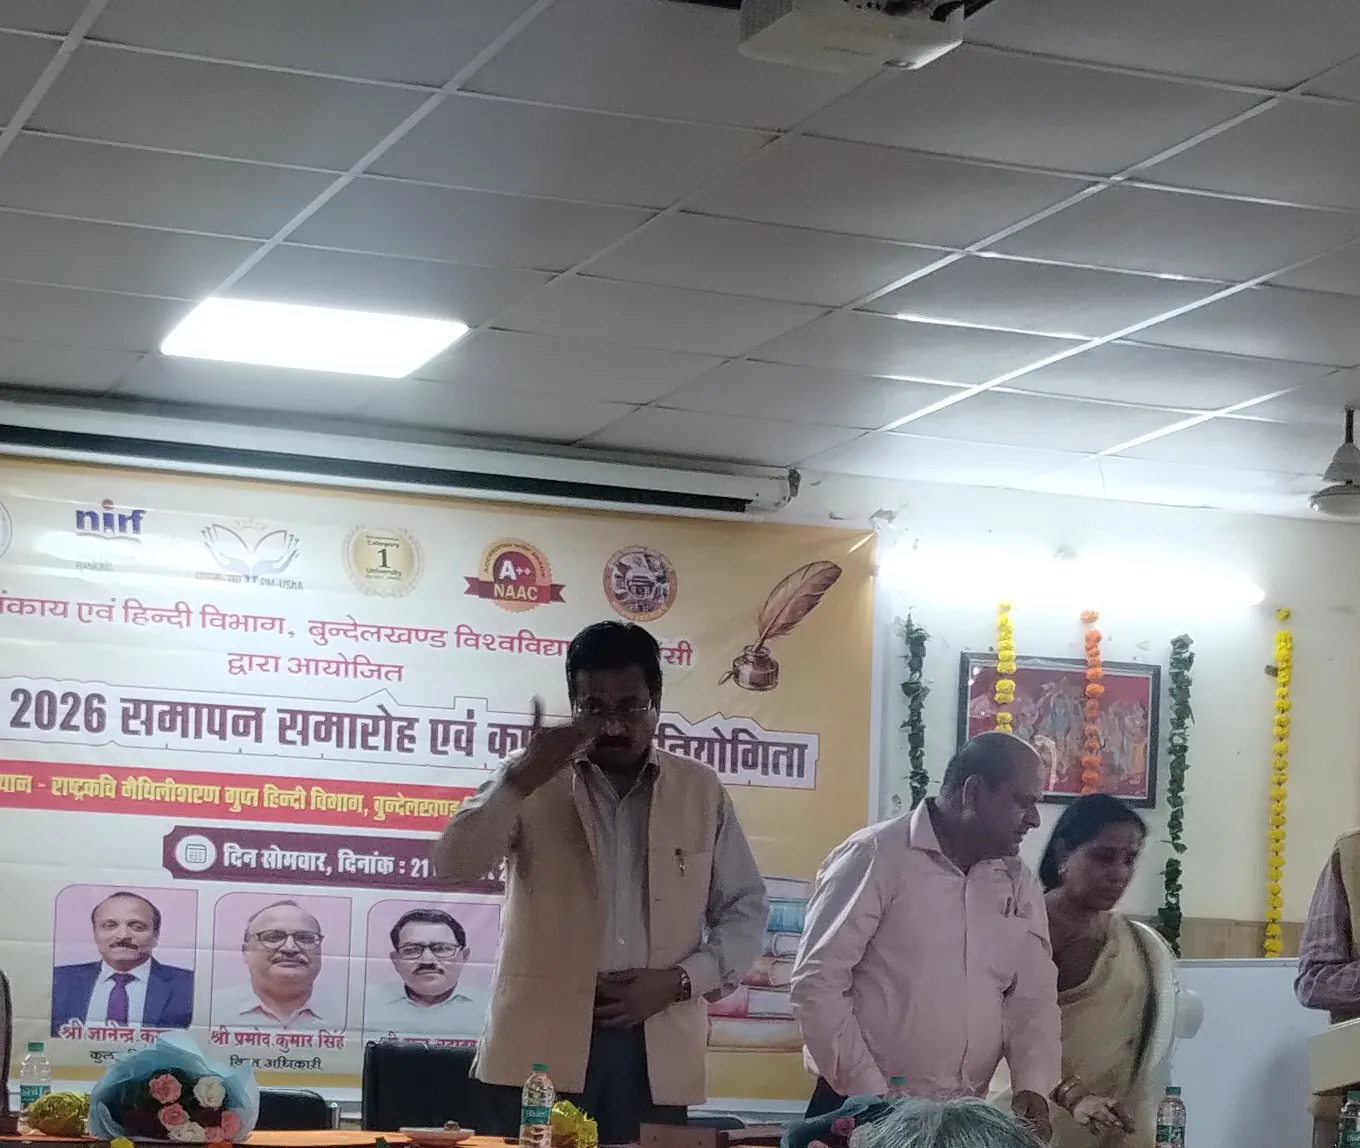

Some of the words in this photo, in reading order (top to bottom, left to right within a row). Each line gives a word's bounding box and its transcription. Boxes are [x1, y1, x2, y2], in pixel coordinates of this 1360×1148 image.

[75, 498, 147, 535] nirf
[377, 549, 391, 568] 1
[499, 560, 532, 580] A++
[493, 583, 538, 601] NAAC
[77, 597, 116, 624] एवं
[122, 598, 193, 629] हिन्दी
[199, 604, 295, 638] विभाग,
[308, 615, 448, 648] बुन्देलखण्ड
[455, 624, 571, 656] विश्वविद्या
[227, 652, 280, 676] द्वारा
[287, 652, 404, 682] आयोजित
[9, 687, 107, 734] 2026
[120, 698, 267, 743] समापन
[277, 703, 420, 753] समारोह
[428, 708, 478, 757] एवं
[51, 773, 117, 801] राष्ट्रकवि
[121, 776, 221, 804] मैथिलीशरण
[263, 783, 307, 810] हिन्दी
[310, 786, 368, 817] विभाग,
[223, 843, 259, 869] दिन
[261, 845, 332, 876] सोमवार,
[338, 849, 395, 875] दिनांक
[61, 1019, 83, 1040] श्री
[210, 1025, 229, 1045] श्री
[234, 1026, 271, 1048] प्रमोद
[276, 1032, 314, 1053] कुमार
[318, 1029, 345, 1050] सिंह
[264, 1056, 322, 1070] अधिकारी
